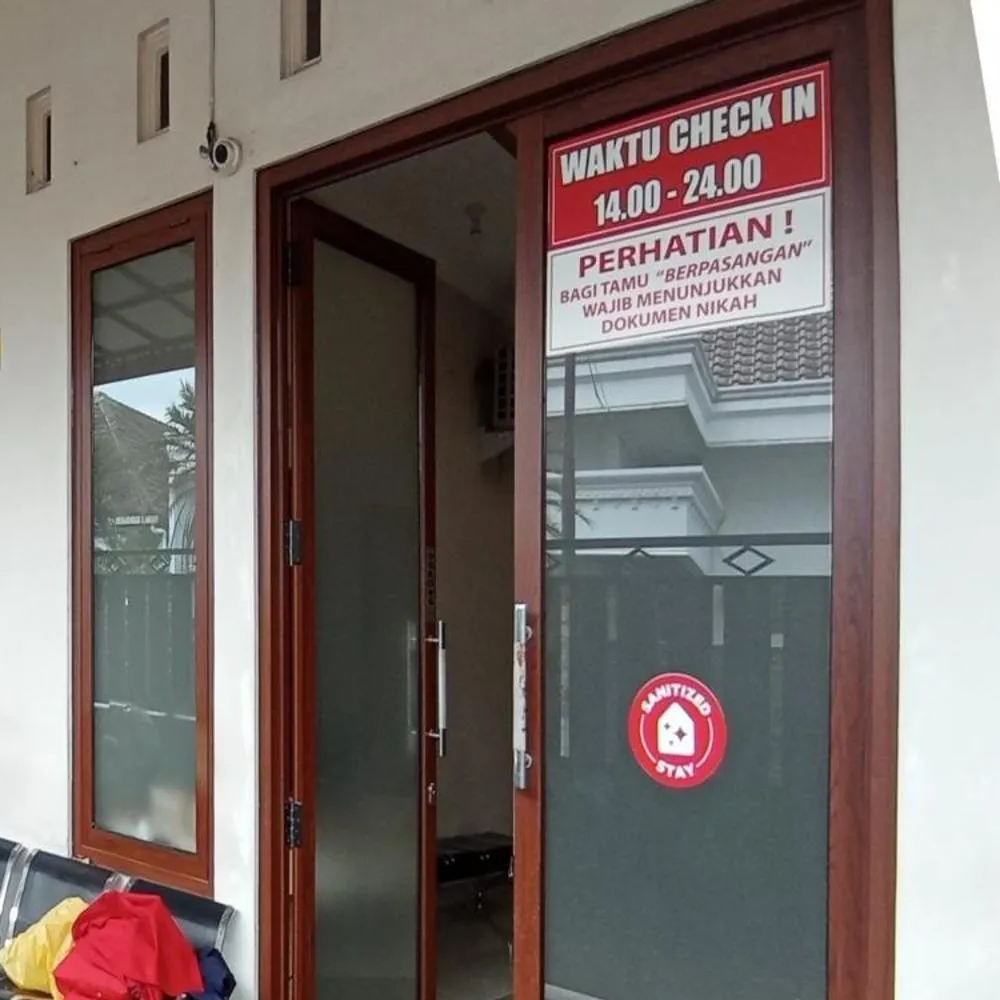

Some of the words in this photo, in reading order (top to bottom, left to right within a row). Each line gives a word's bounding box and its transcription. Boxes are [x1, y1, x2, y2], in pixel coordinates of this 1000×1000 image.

[560, 125, 661, 185] WAKTU
[668, 93, 774, 154] CHECK
[781, 82, 816, 124] IN
[594, 180, 661, 227] 14.00
[666, 190, 678, 200] -
[683, 153, 762, 205] 24.00
[579, 214, 772, 278] PERHATIAN
[785, 209, 794, 234] !
[560, 285, 597, 304] BAGI
[600, 273, 649, 295] TAMU
[582, 297, 632, 318] WAJIB
[637, 268, 782, 308] MENUNJUKKAN
[601, 306, 691, 334] DOKUMEN
[696, 294, 757, 316] NIKAH
[641, 683, 712, 717] SANITIZED
[656, 760, 694, 779] STAY
